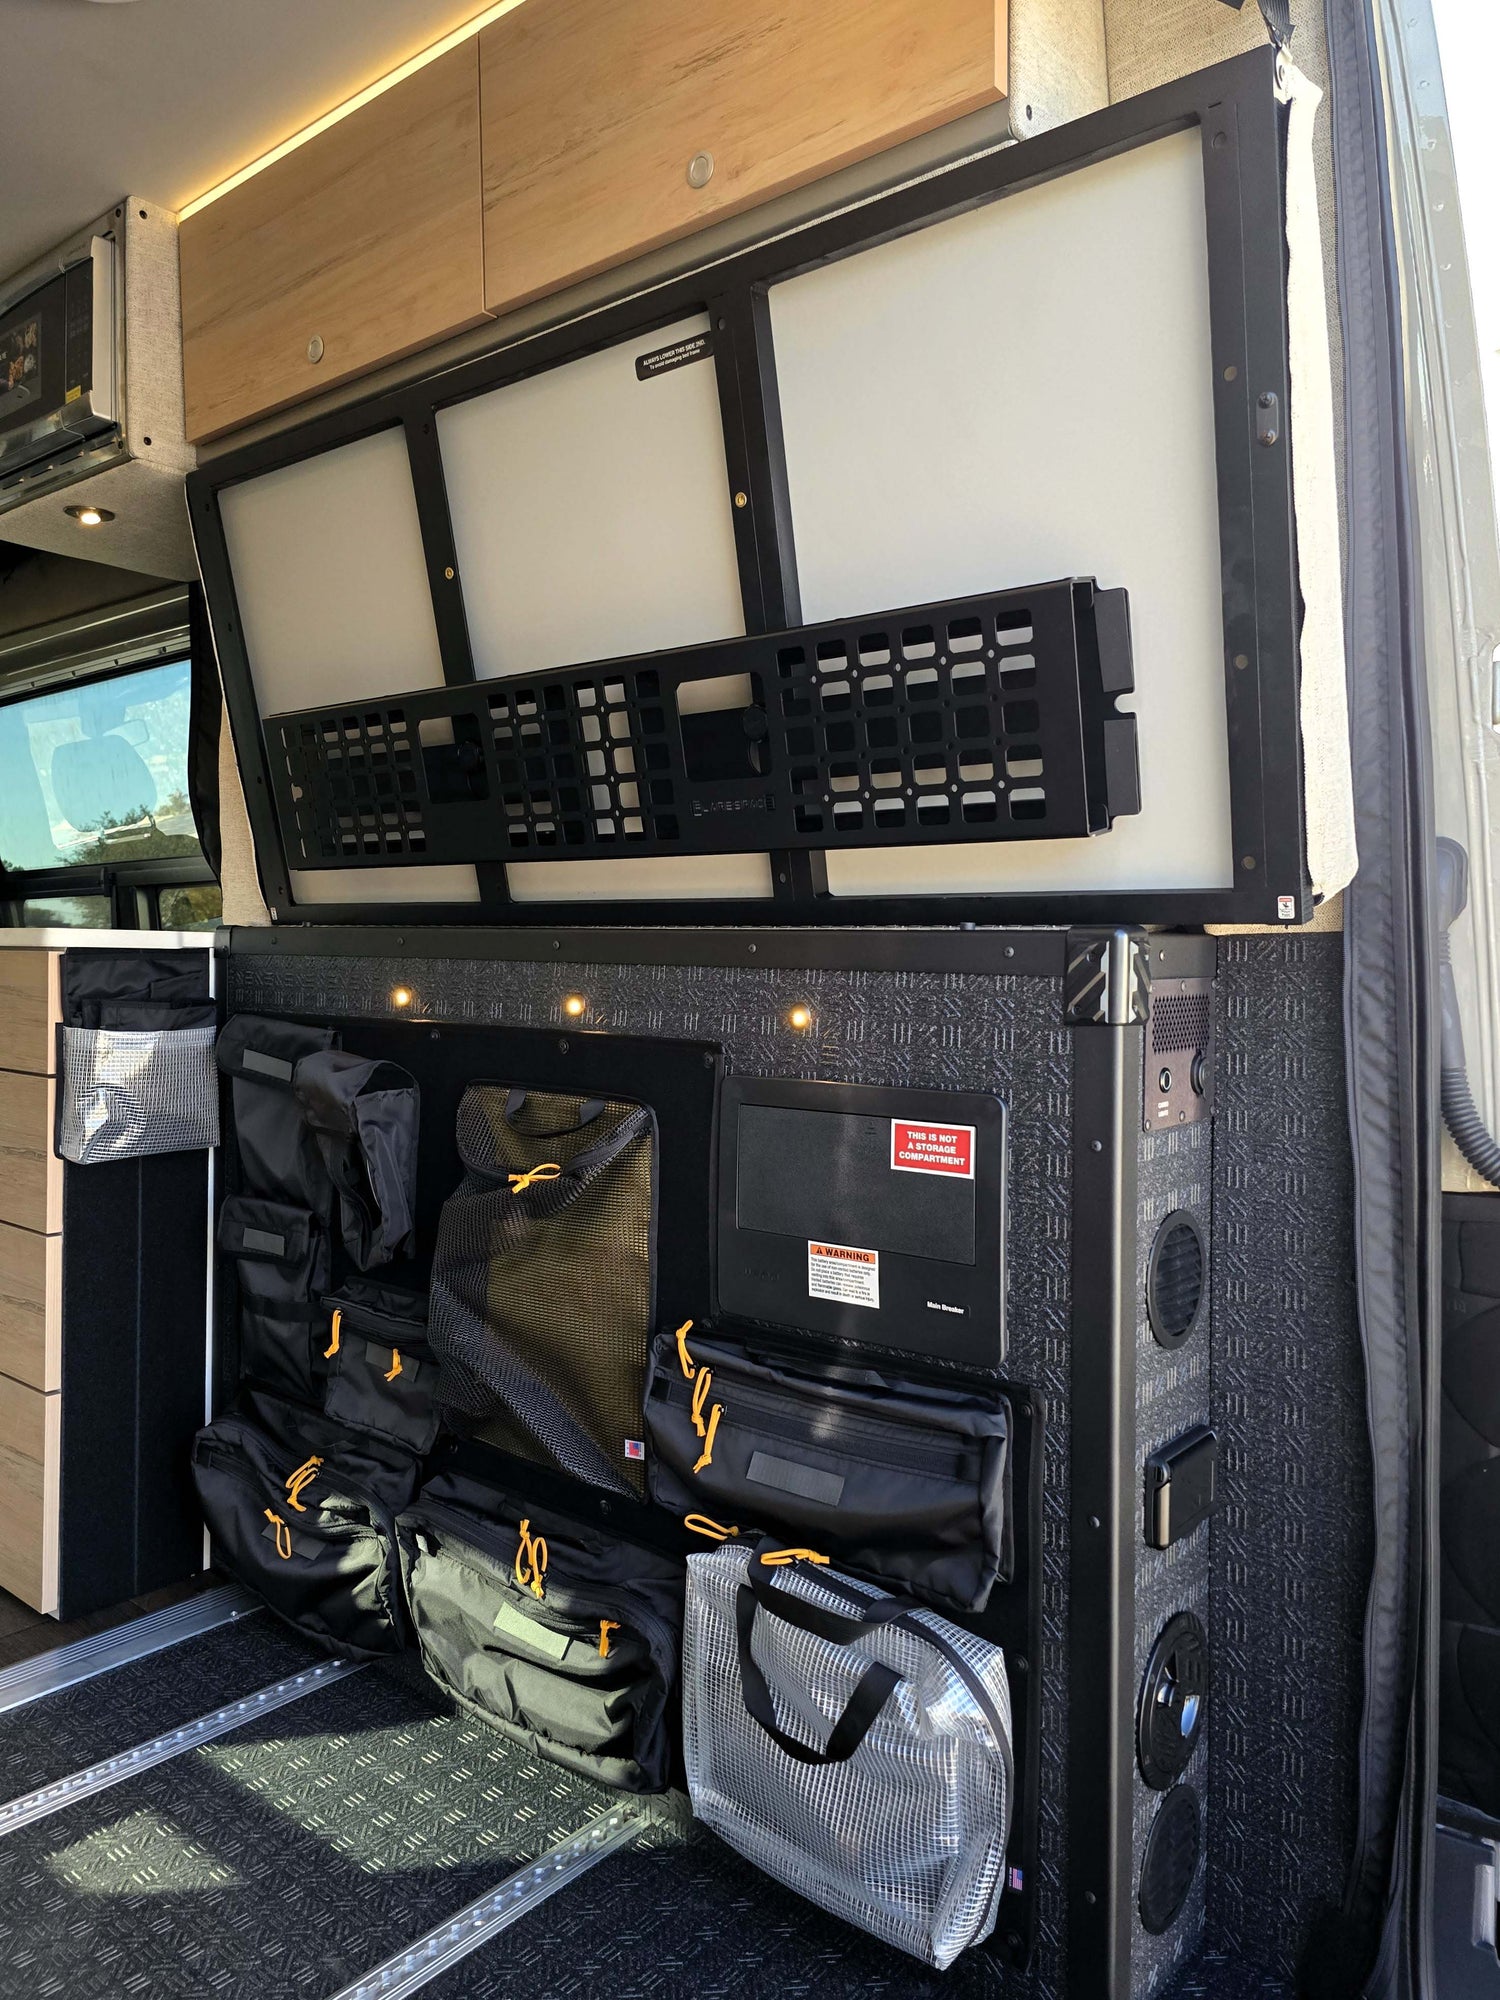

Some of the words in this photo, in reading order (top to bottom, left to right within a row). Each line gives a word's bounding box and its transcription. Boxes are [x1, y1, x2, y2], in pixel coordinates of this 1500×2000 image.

[643, 356, 659, 366] ALWAYS
[660, 350, 675, 360] LOWER
[686, 343, 695, 351] SIDE
[665, 355, 682, 364] damaging
[907, 1131, 926, 1140] THIS
[939, 1134, 957, 1143] NOT
[916, 1143, 956, 1154] STORAGE
[899, 1151, 965, 1166] COMPARTMENT
[826, 1247, 869, 1261] WARNING
[927, 1301, 941, 1310] Main
[942, 1304, 964, 1314] Breaker
